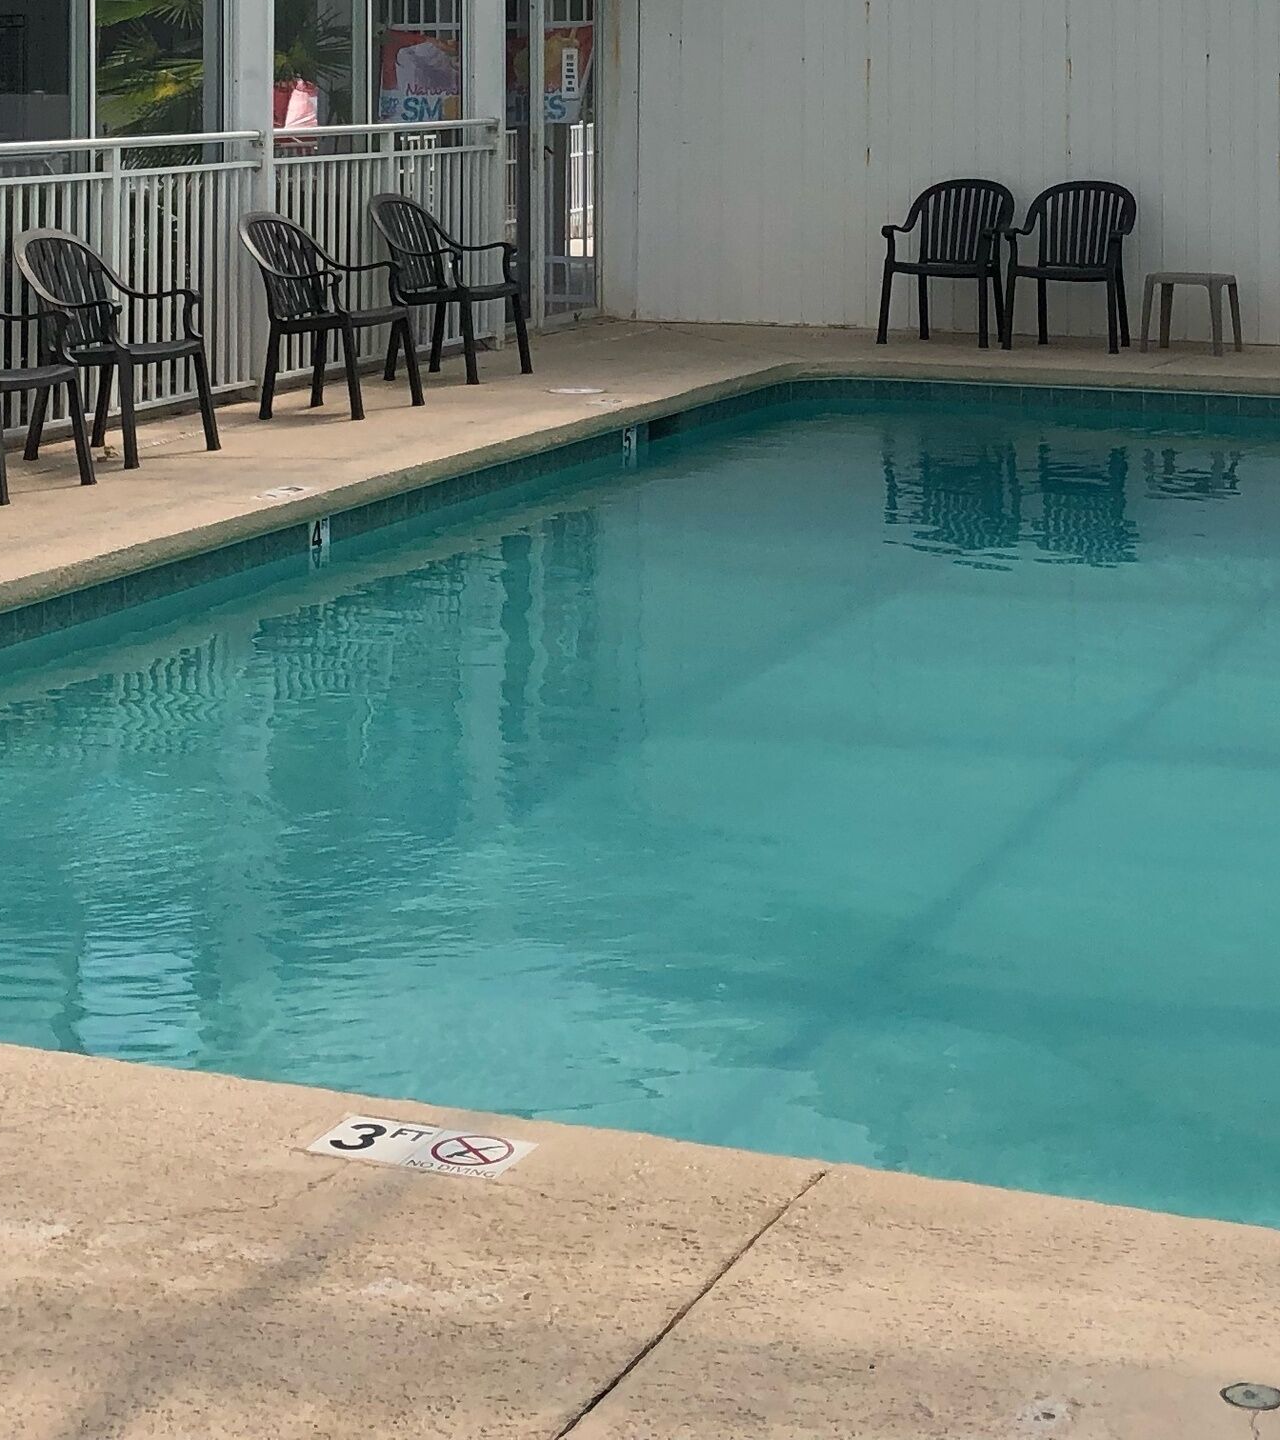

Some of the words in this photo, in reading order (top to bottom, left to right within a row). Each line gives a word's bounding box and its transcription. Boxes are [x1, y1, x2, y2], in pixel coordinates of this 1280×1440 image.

[312, 521, 322, 547] 4
[329, 1123, 387, 1150] 3
[389, 1128, 433, 1142] FT
[406, 1159, 433, 1168] NO
[438, 1164, 496, 1178] DIVING
